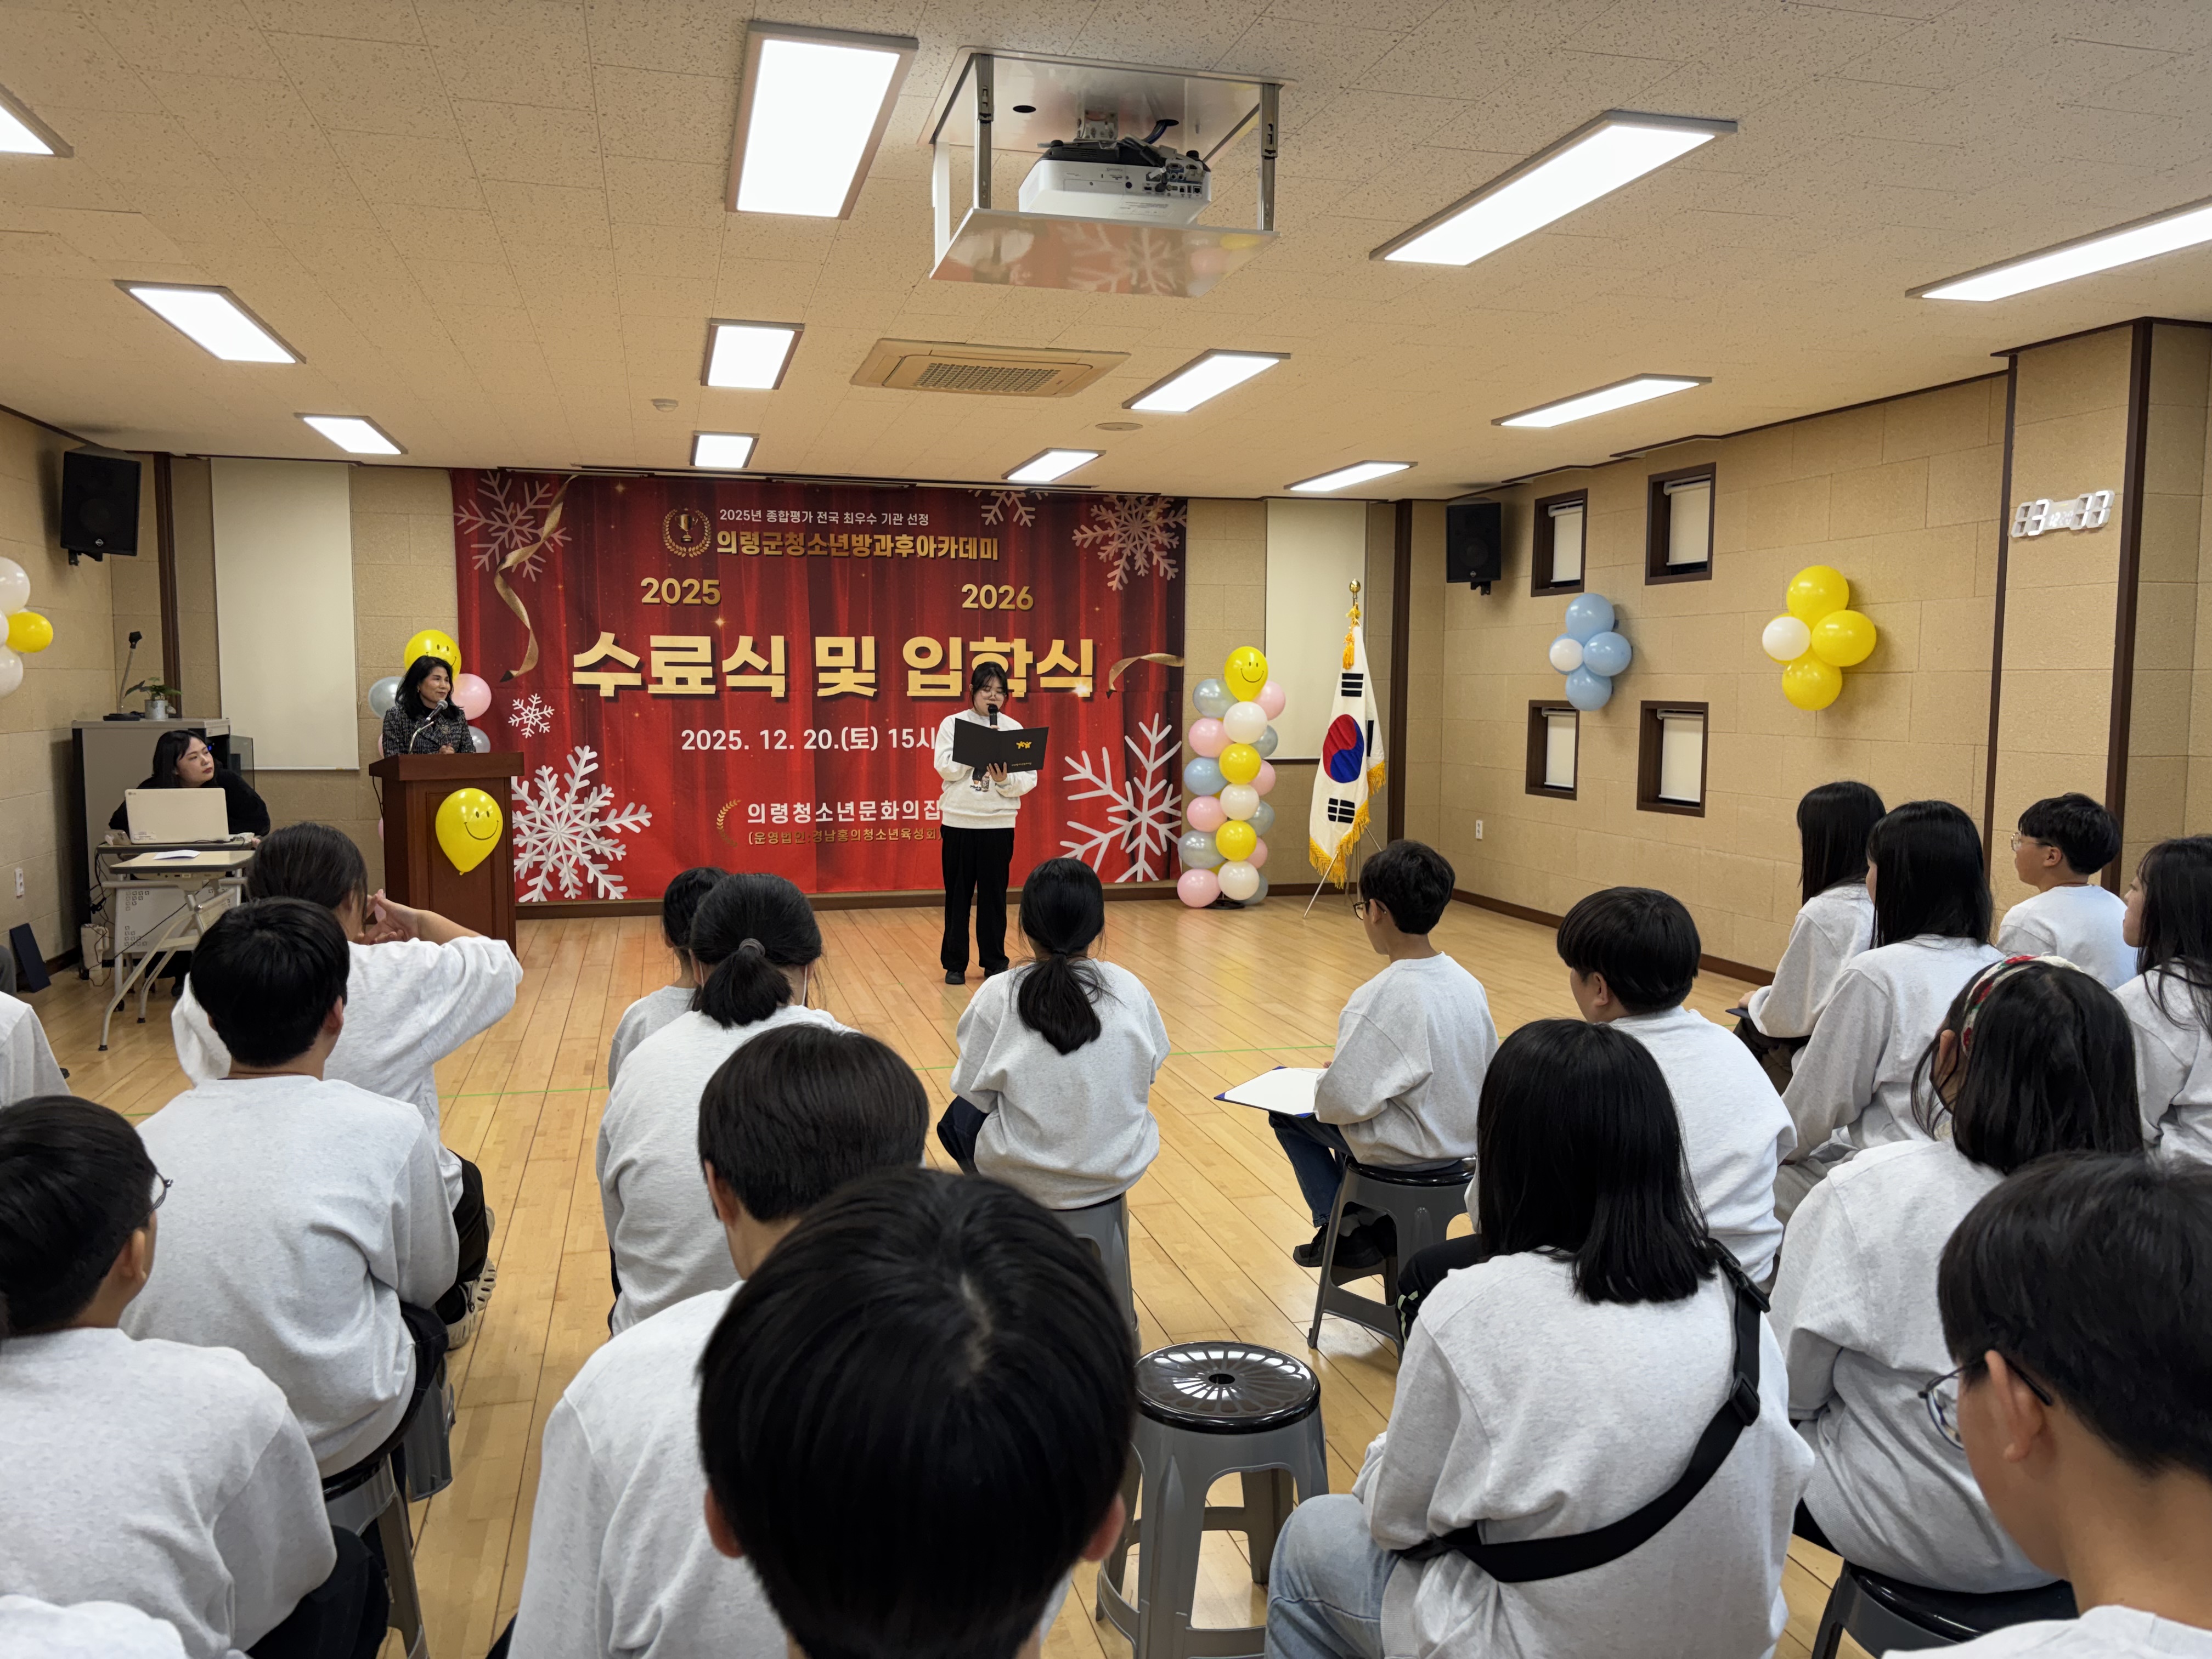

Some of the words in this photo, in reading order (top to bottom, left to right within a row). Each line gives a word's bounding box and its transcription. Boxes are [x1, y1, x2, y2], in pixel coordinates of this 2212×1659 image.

[719, 509, 762, 522] 2025년
[766, 510, 813, 523] 종합평가
[817, 511, 839, 524] 전국
[843, 512, 877, 525] 최우수
[881, 512, 904, 525] 기관
[907, 513, 929, 526] 선정
[2081, 490, 2109, 527] 17
[717, 531, 998, 561] 의령군청소년방과후아카데미
[640, 577, 721, 605] 2025
[961, 583, 1034, 611] 2026
[572, 631, 786, 698] 수료식
[815, 635, 878, 697] 및
[902, 636, 1094, 698] 입학식
[681, 729, 750, 751] 2025.
[759, 729, 795, 750] 12.
[803, 726, 878, 752] 20.(토)
[888, 727, 935, 749] 15시
[747, 800, 940, 824] 의령청소년문화의집
